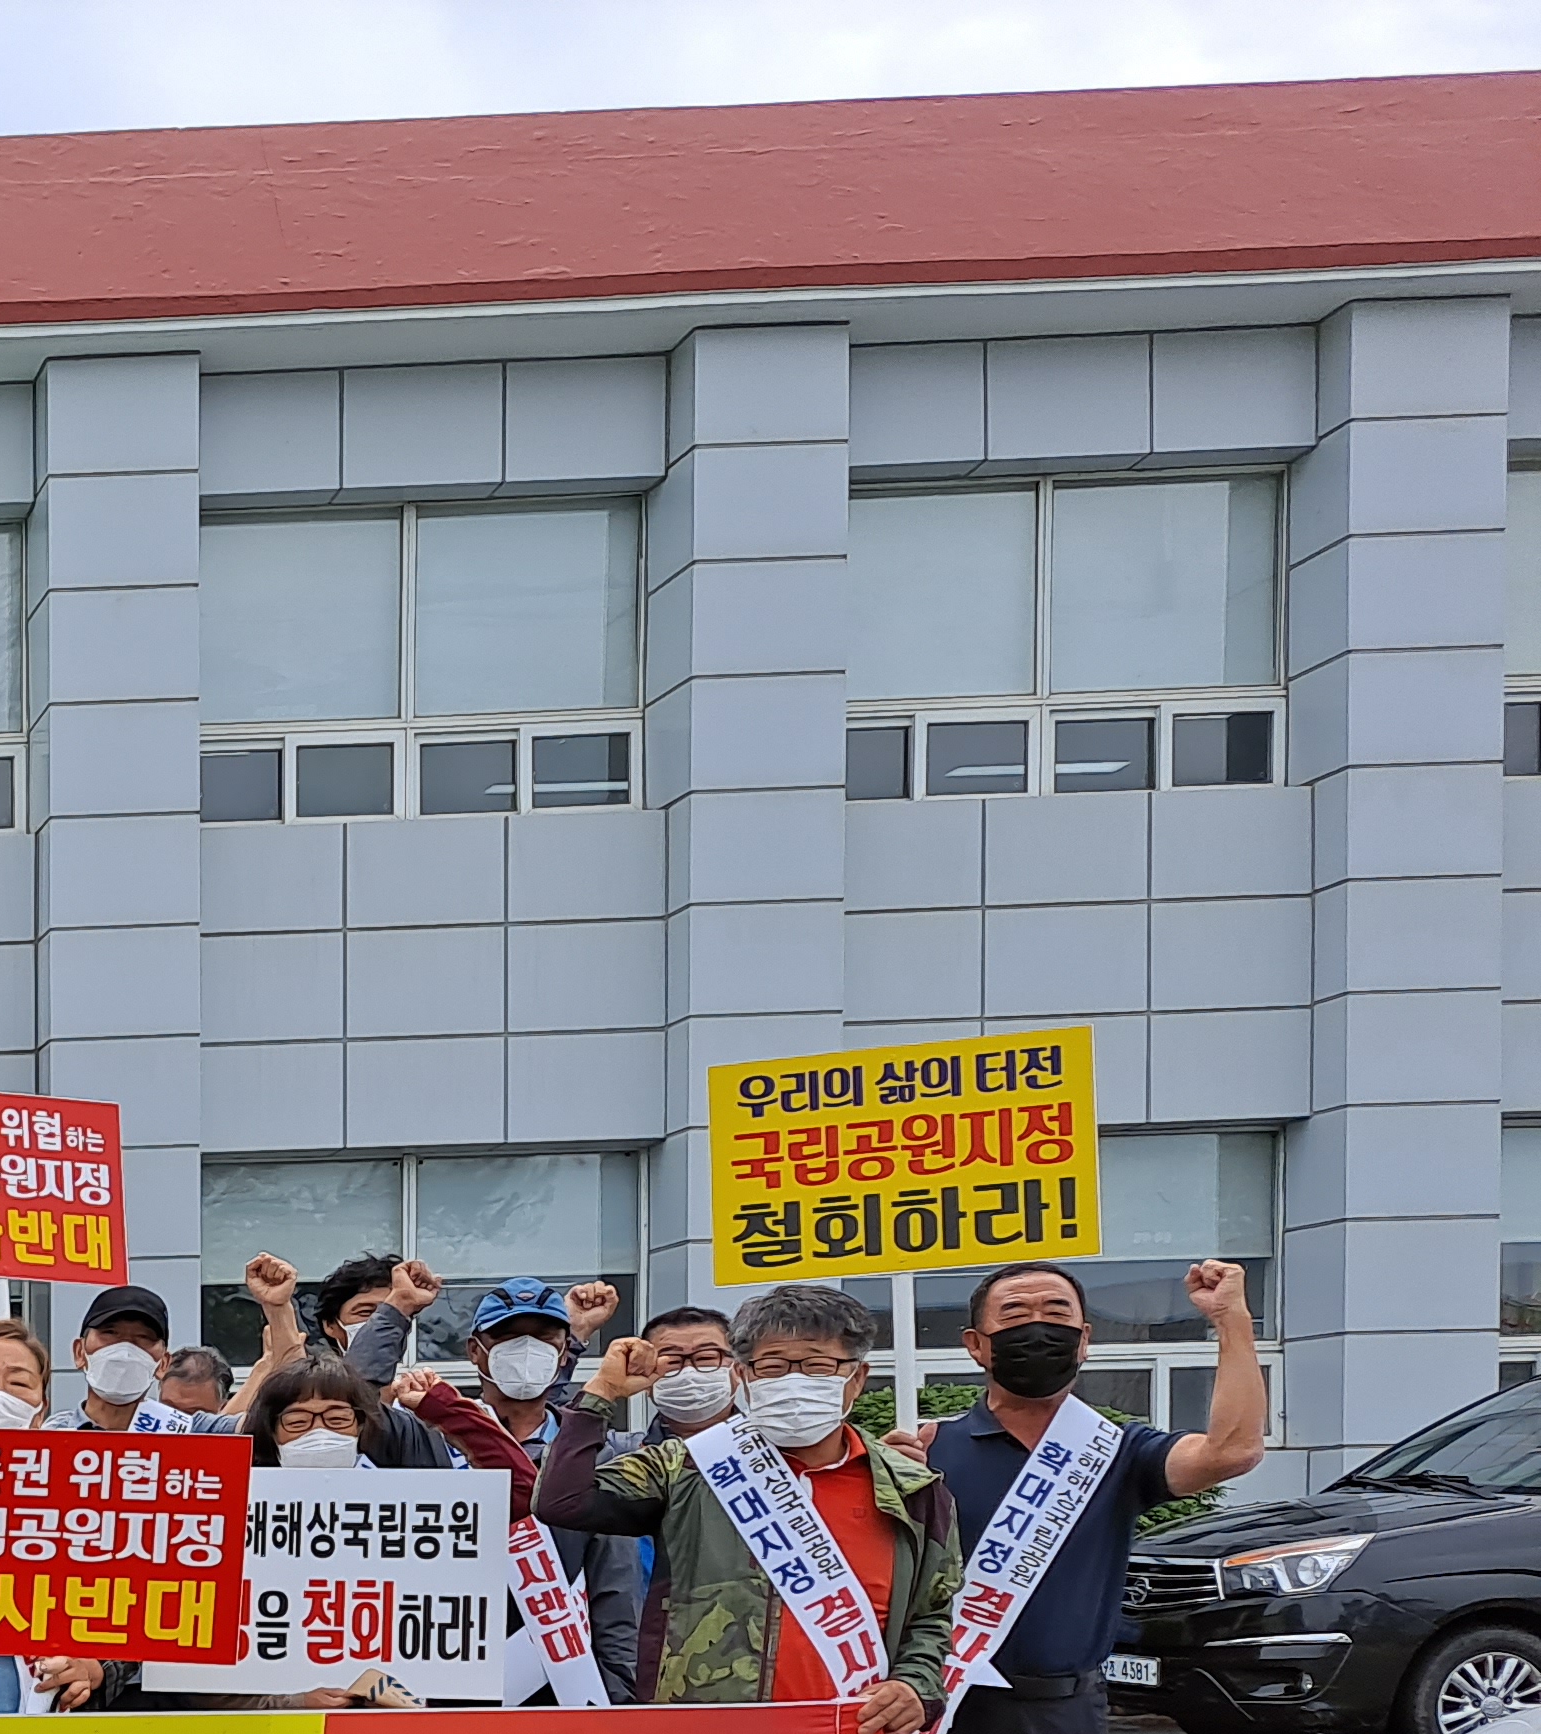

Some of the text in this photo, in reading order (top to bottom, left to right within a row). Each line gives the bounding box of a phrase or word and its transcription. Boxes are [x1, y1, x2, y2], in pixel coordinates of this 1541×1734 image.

[737, 1044, 1063, 1118] 우리의 삶의 터전
[0, 1107, 105, 1153] 위협하는
[731, 1101, 1074, 1189] 국립공원지정
[732, 1176, 1078, 1268] 철회하라!
[69, 1450, 222, 1500] 위협하는
[725, 1410, 847, 1581] 도해해상국립공원
[978, 1441, 1072, 1574] 확대지정
[1009, 1420, 1124, 1589] 다도해해상국립공원
[707, 1455, 815, 1594] 확대지정
[302, 1579, 487, 1665] 철회하라!
[804, 1586, 883, 1697] 결사
